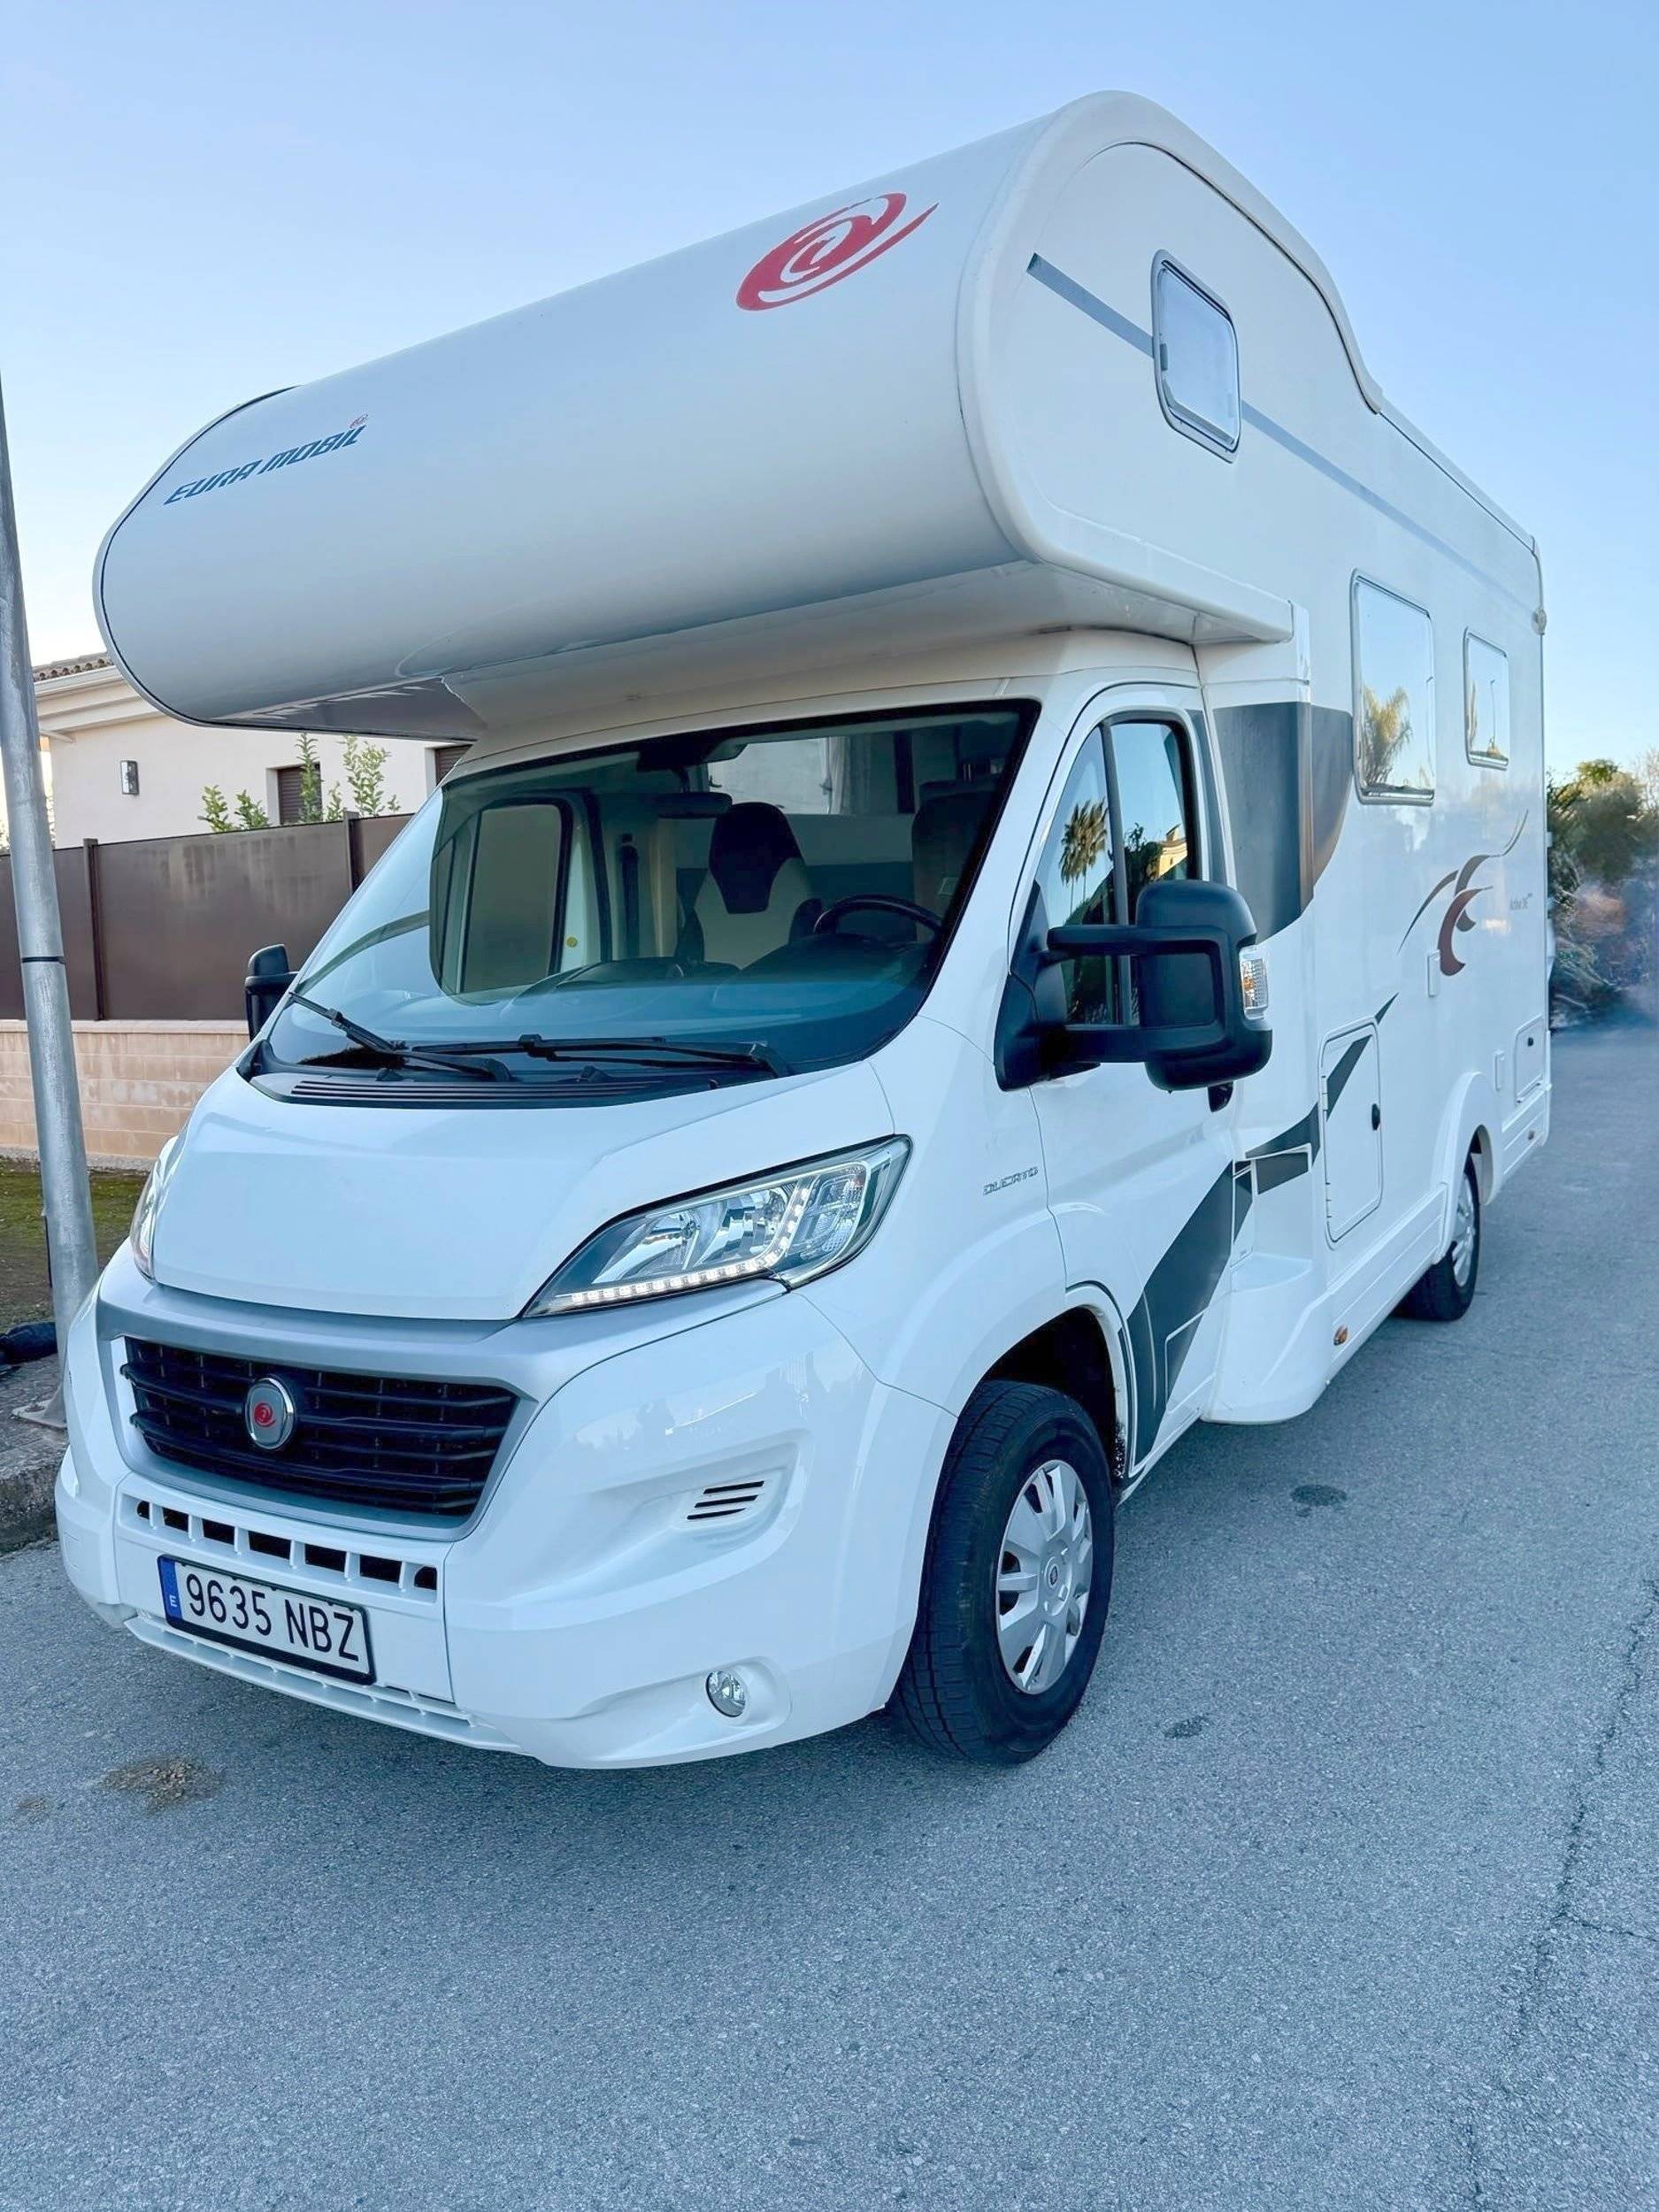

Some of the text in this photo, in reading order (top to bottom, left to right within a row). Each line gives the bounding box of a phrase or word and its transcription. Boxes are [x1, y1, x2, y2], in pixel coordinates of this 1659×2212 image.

[163, 425, 367, 506] EURA MOBIL
[983, 1166, 1039, 1195] DUCATO
[169, 1594, 178, 1608] E
[186, 1573, 359, 1662] 9635 NBZ
